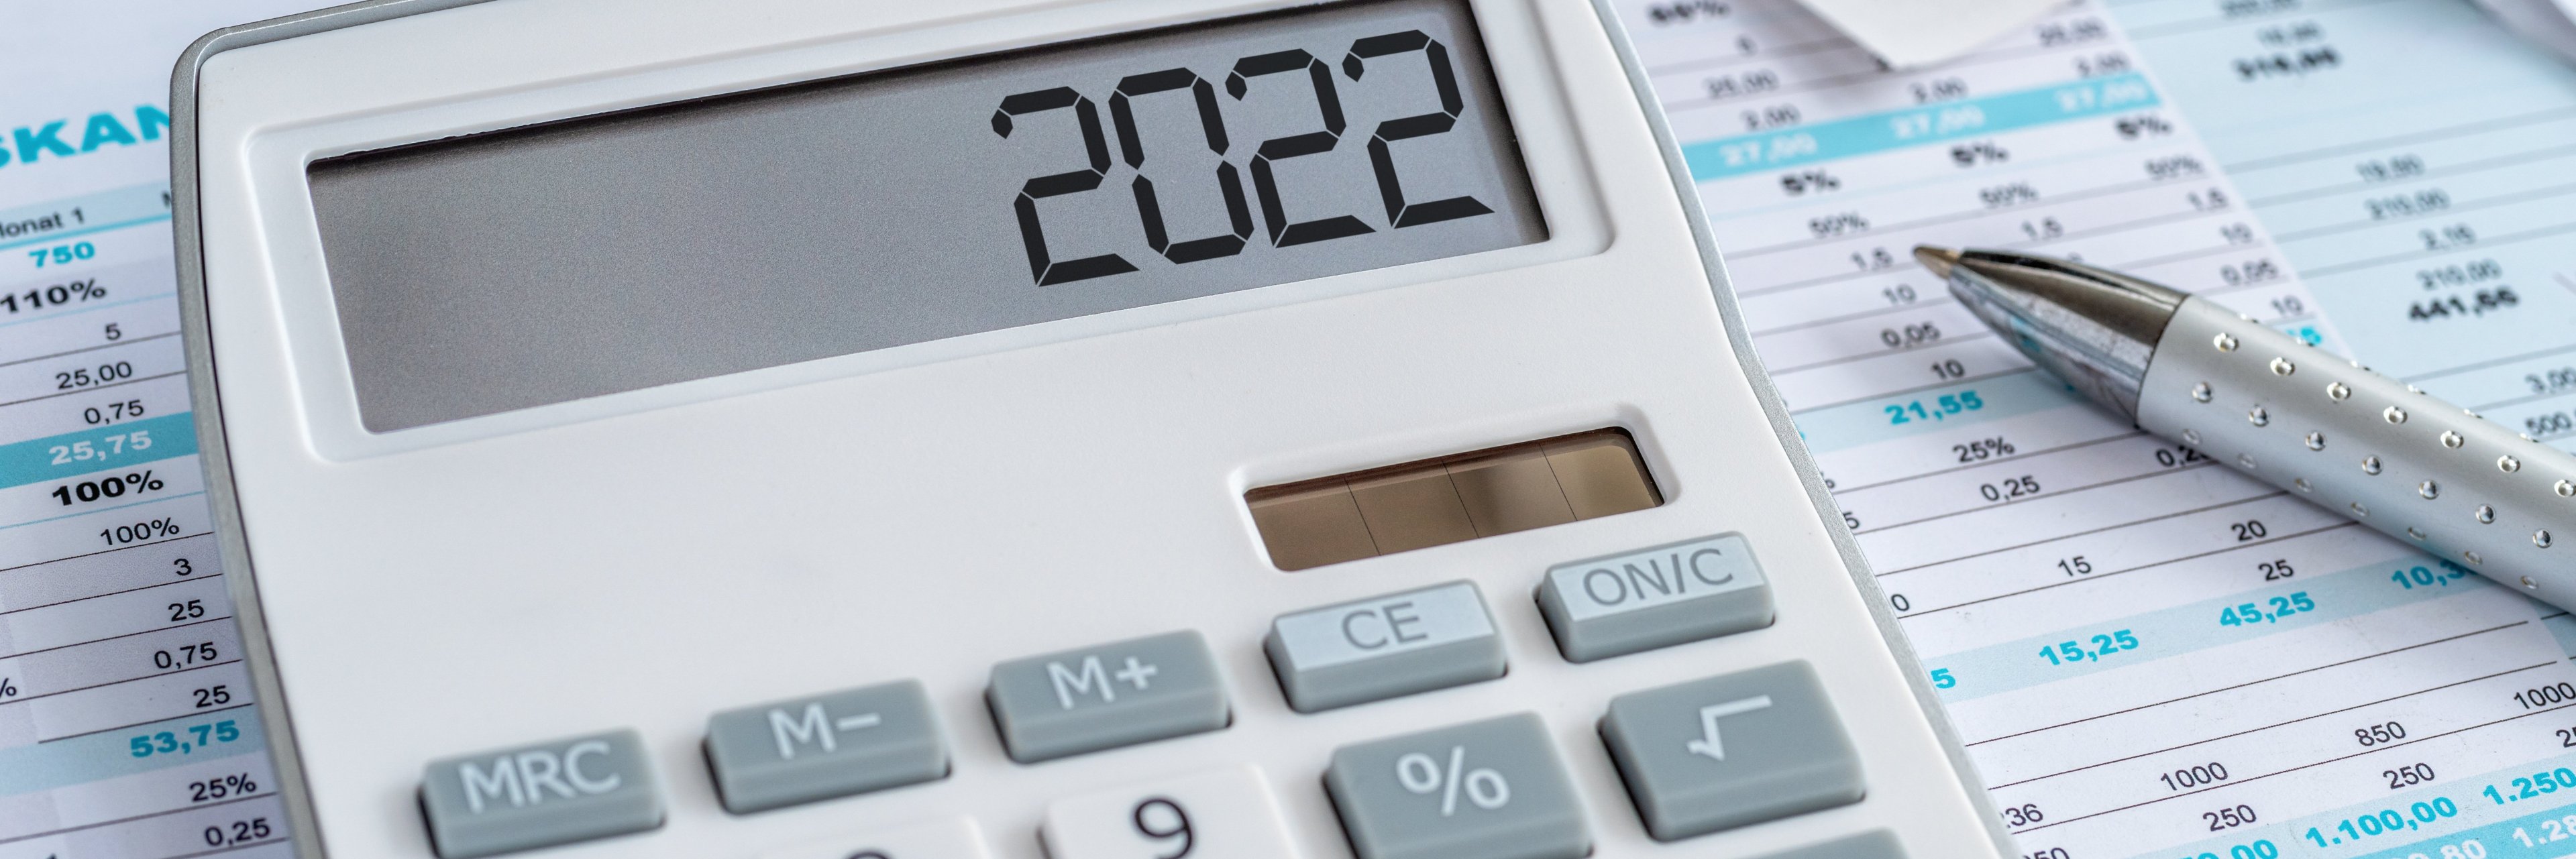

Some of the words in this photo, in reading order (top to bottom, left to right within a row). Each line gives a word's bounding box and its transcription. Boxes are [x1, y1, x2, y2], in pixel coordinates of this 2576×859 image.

[0, 105, 169, 167] KAN
[991, 30, 1495, 286] 2022
[0, 212, 64, 237] onat
[72, 207, 85, 224] 1
[29, 241, 95, 268] 750
[0, 278, 105, 313] 110%
[1882, 284, 1917, 304] 10
[105, 323, 121, 340] 5
[1931, 359, 1965, 379] 10
[2271, 295, 2304, 315] 10
[56, 361, 132, 390] 25,00
[84, 400, 144, 426] 0,75
[1884, 390, 1984, 425] 21,55
[2524, 411, 2576, 436] 500
[48, 431, 152, 465] 25,75
[1952, 436, 2014, 463] 25%
[52, 470, 164, 506] 100%
[1980, 475, 2041, 504] 0,25
[101, 517, 179, 546] 100%
[2058, 555, 2092, 577] 15
[2231, 520, 2267, 541] 20
[174, 558, 192, 575] 3
[1583, 548, 1735, 606] ON/C
[2257, 559, 2294, 581] 25
[168, 599, 205, 621] 25
[1341, 602, 1429, 650] CE
[2039, 629, 2139, 666] 15,25
[2220, 591, 2315, 627] 45,25
[2392, 559, 2478, 589] 10,3
[154, 642, 217, 670] 0,75
[193, 685, 230, 708] 25
[1048, 654, 1158, 708] M+
[131, 720, 239, 758] 53,75
[2160, 762, 2228, 791] 1000
[2355, 721, 2406, 746] 850
[2514, 682, 2576, 709] 1000
[189, 772, 256, 802] 25%
[458, 740, 621, 814] MRC
[1396, 746, 1511, 816] %
[2203, 804, 2257, 832] 250
[2383, 762, 2435, 789] 250
[205, 817, 270, 847] 0,25
[1133, 798, 1193, 859] 9
[2305, 797, 2458, 848] 1.100,00
